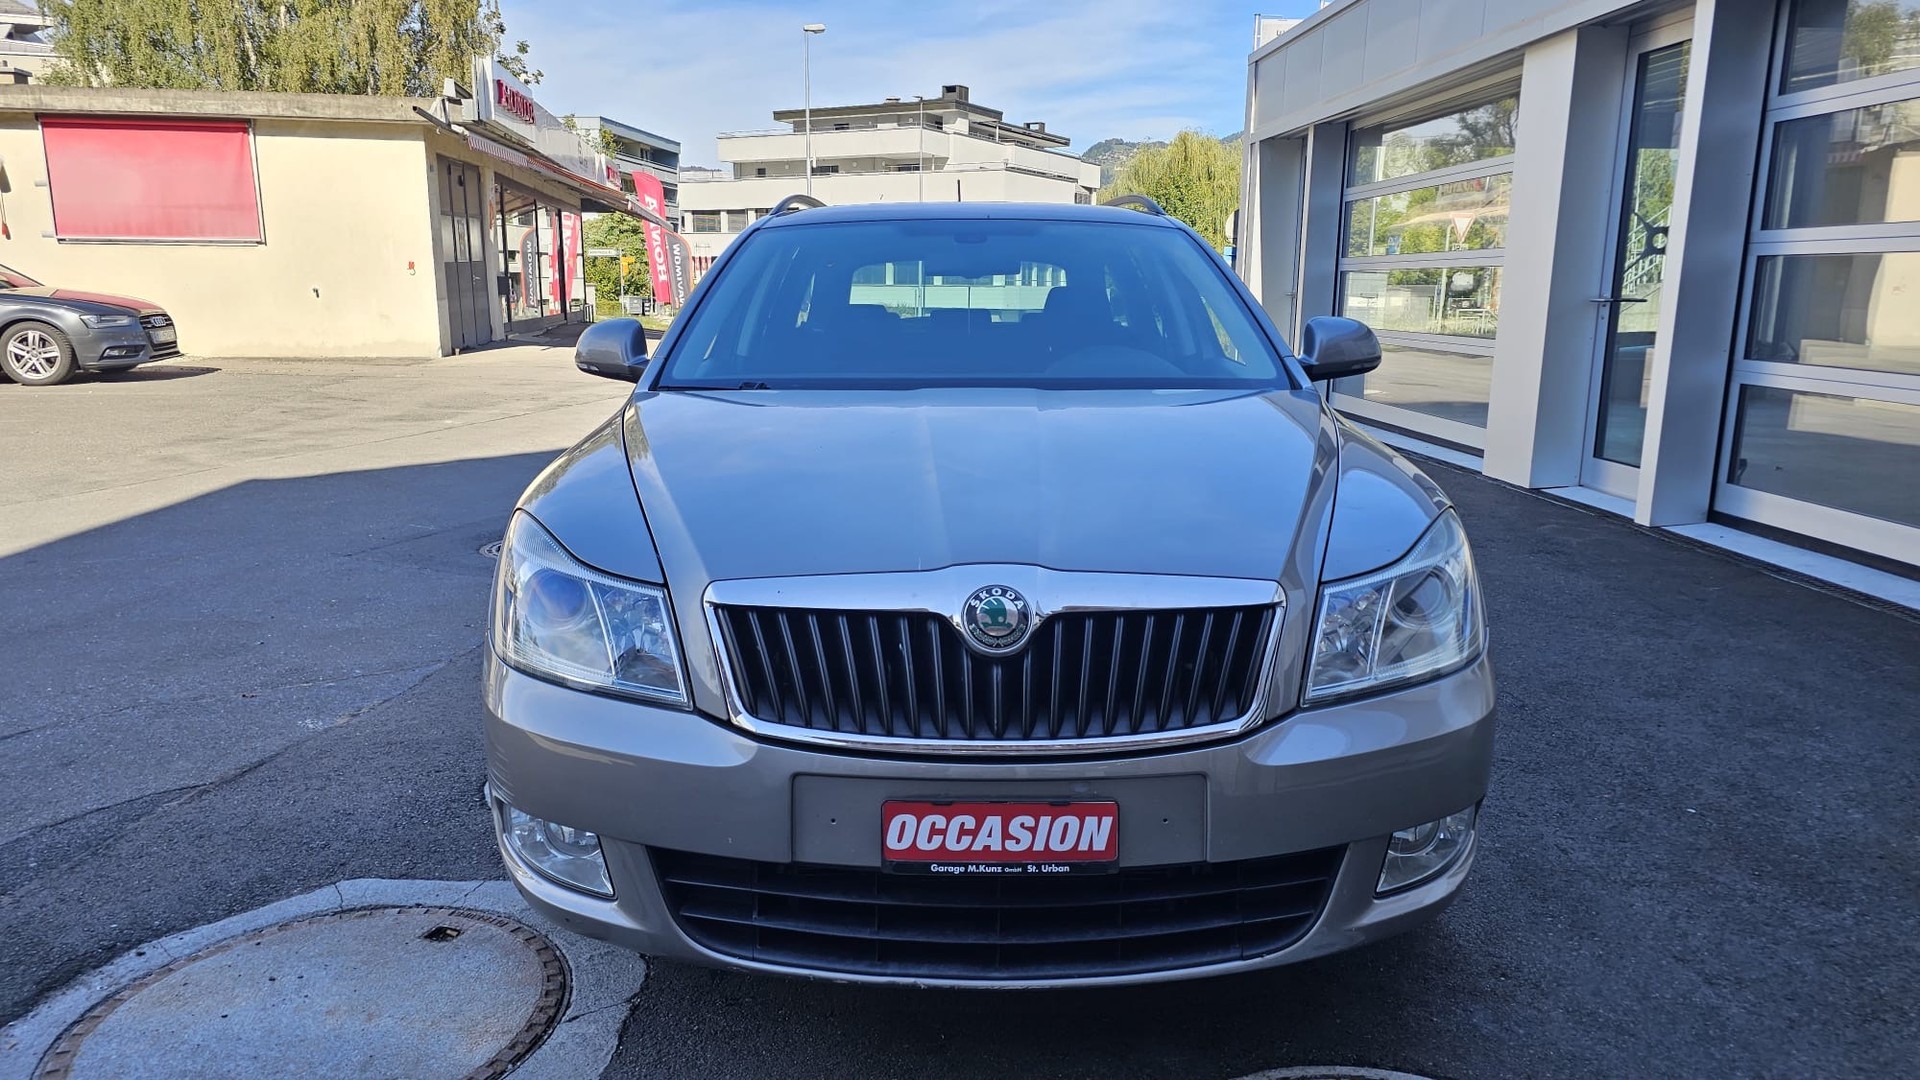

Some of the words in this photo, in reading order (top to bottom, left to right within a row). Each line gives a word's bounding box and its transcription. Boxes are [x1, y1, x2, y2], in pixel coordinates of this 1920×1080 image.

[526, 240, 536, 305] NAVIMOW
[886, 814, 1113, 851] OCCASION
[931, 864, 965, 874] Garage
[968, 865, 1002, 873] M.Kunz
[1027, 865, 1039, 873] St.
[1041, 864, 1070, 873] Urban
